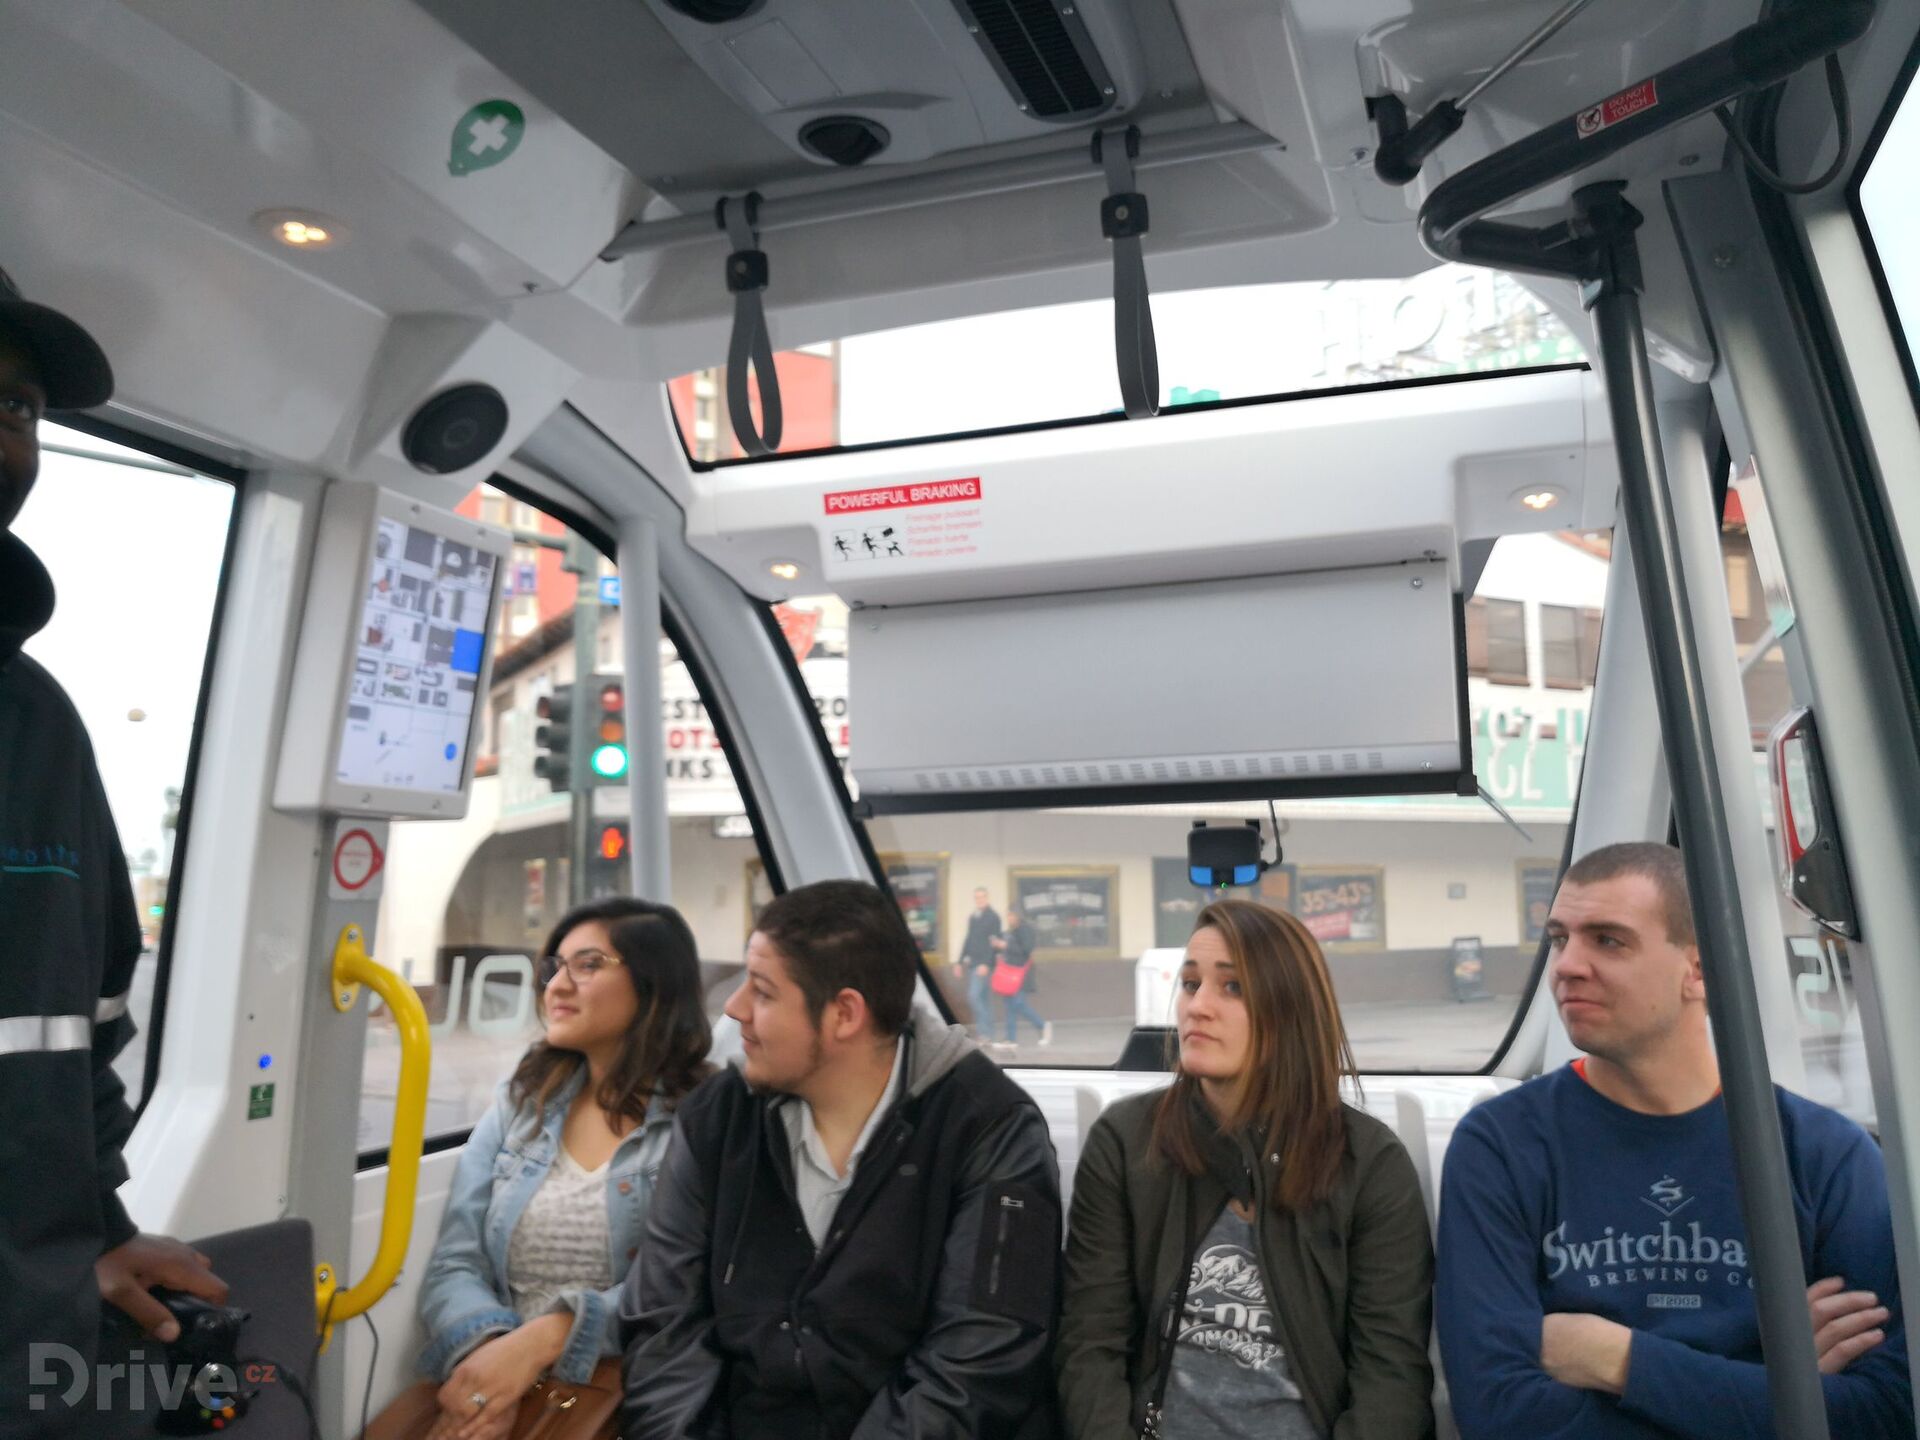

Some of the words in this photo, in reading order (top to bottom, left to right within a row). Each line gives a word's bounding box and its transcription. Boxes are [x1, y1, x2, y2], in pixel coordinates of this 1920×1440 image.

[1608, 96, 1624, 109] DO
[1625, 86, 1647, 100] NOT
[1611, 95, 1648, 118] TOUCH
[828, 489, 908, 510] POWERFUL
[910, 482, 977, 502] BRAKING
[1542, 1220, 1748, 1280] Switchba
[1587, 1267, 1710, 1288] BREWING
